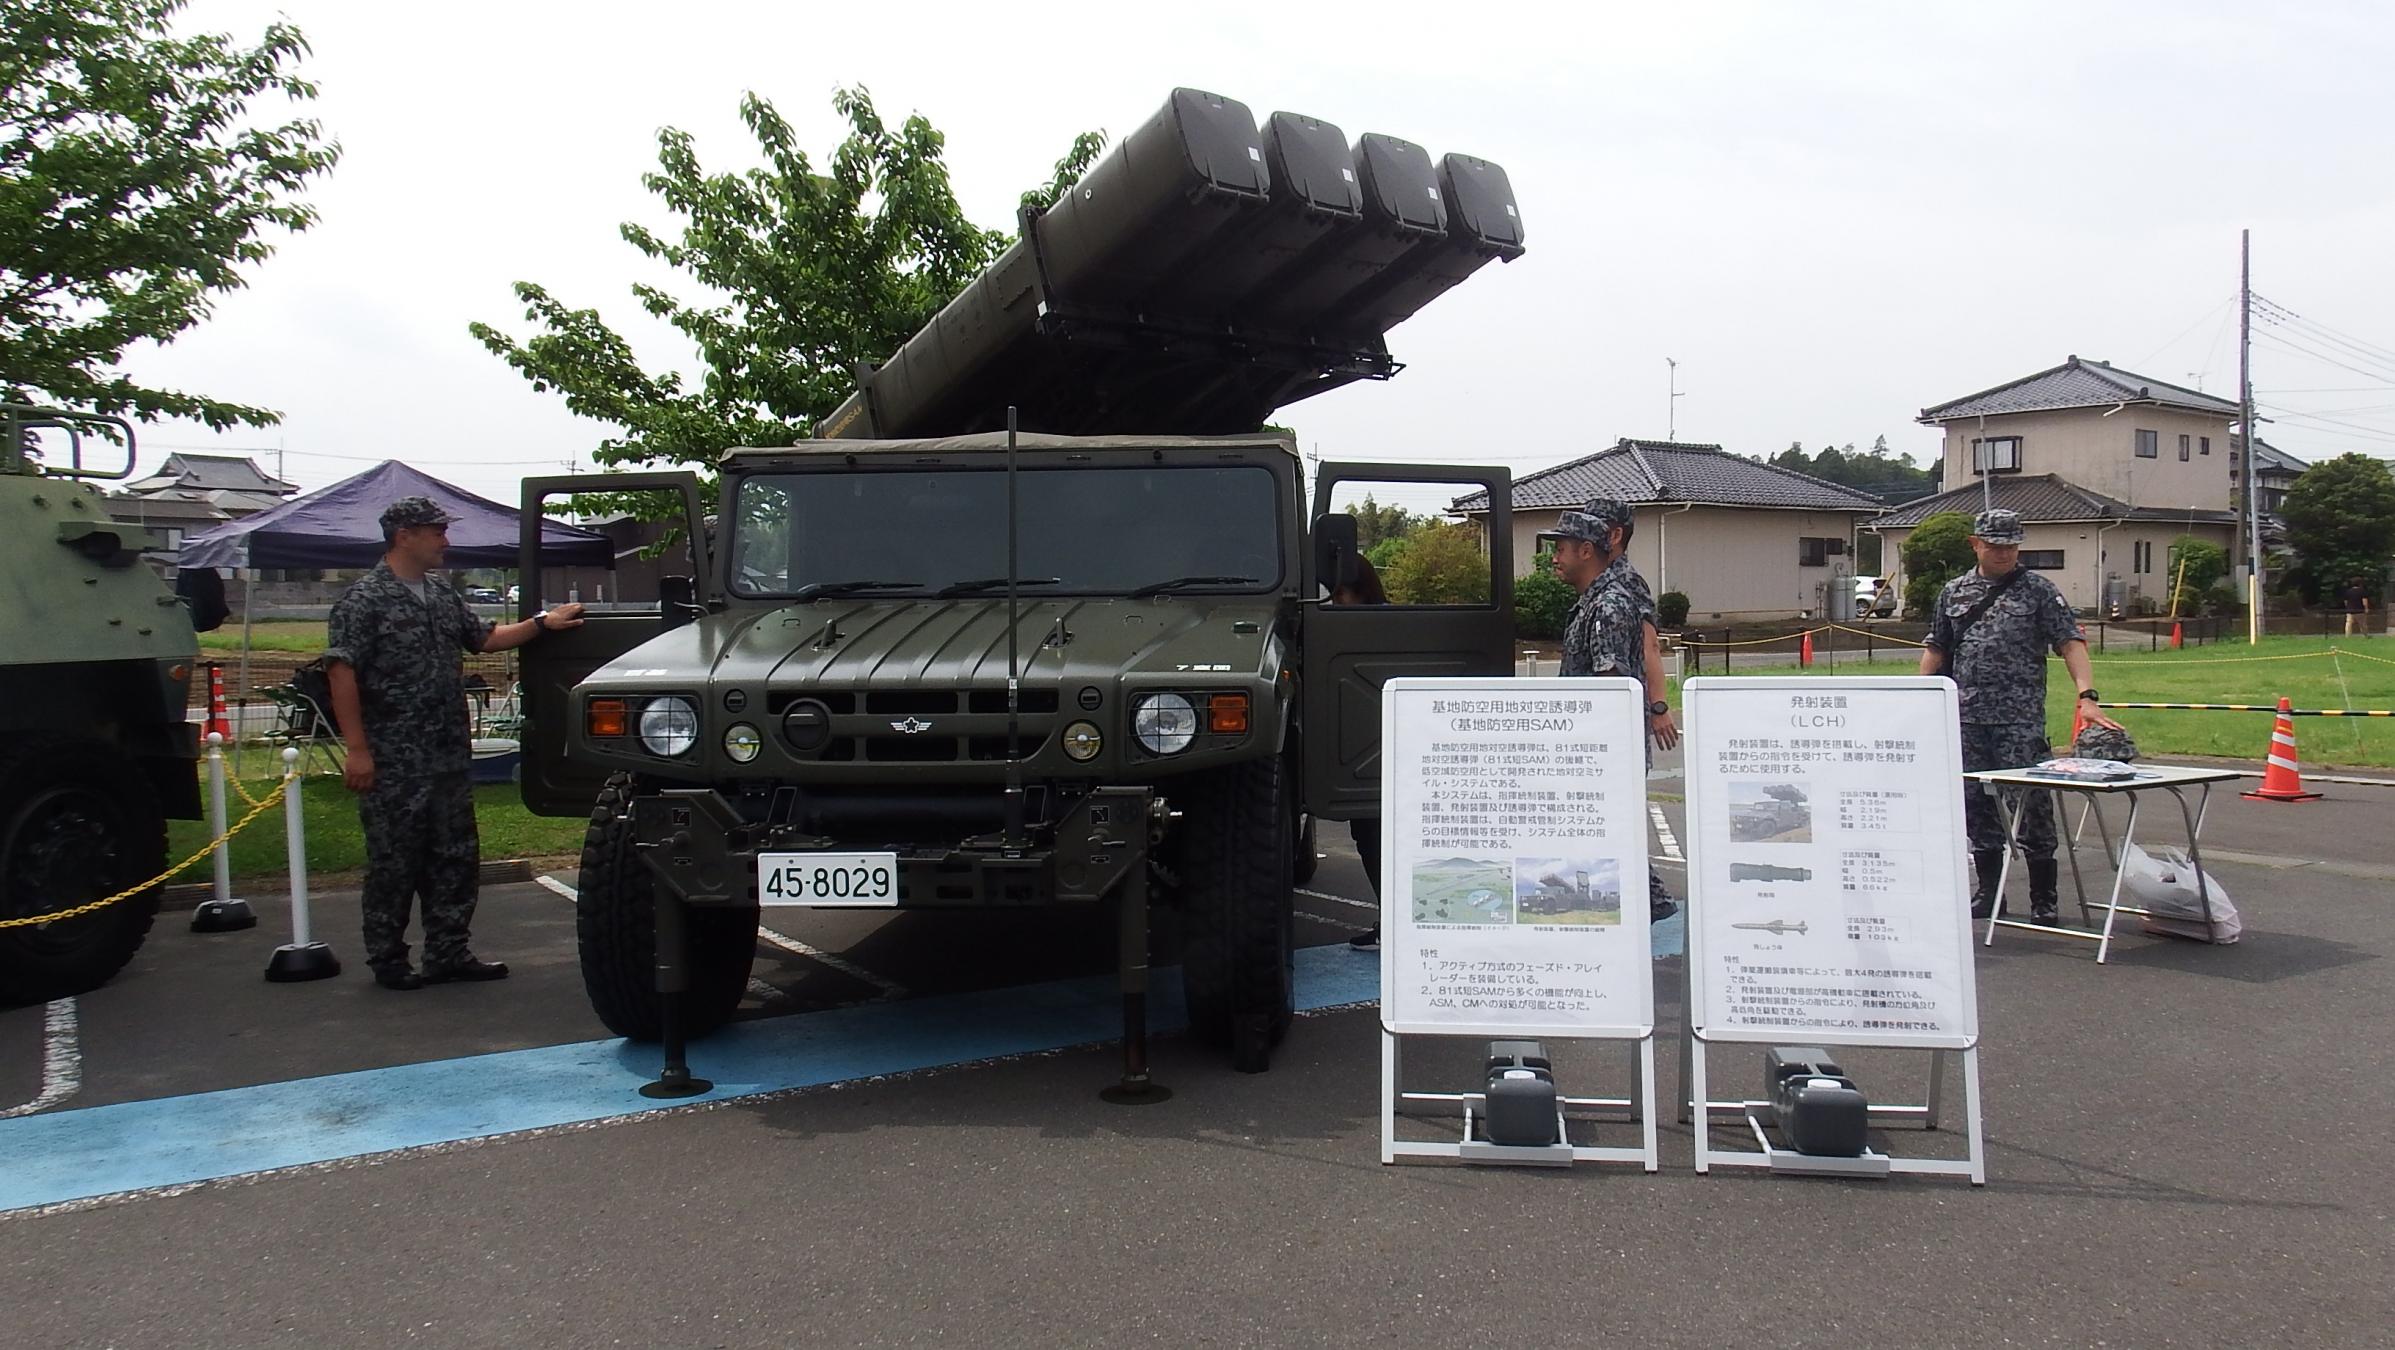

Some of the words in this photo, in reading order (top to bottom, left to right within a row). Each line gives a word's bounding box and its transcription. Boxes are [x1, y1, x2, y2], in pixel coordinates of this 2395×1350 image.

[1432, 700, 1592, 714] 基地防空用地対空誘導弾
[1791, 696, 1847, 708] 発射装置
[767, 867, 889, 898] 45-8029
[1420, 949, 1438, 958] 特性
